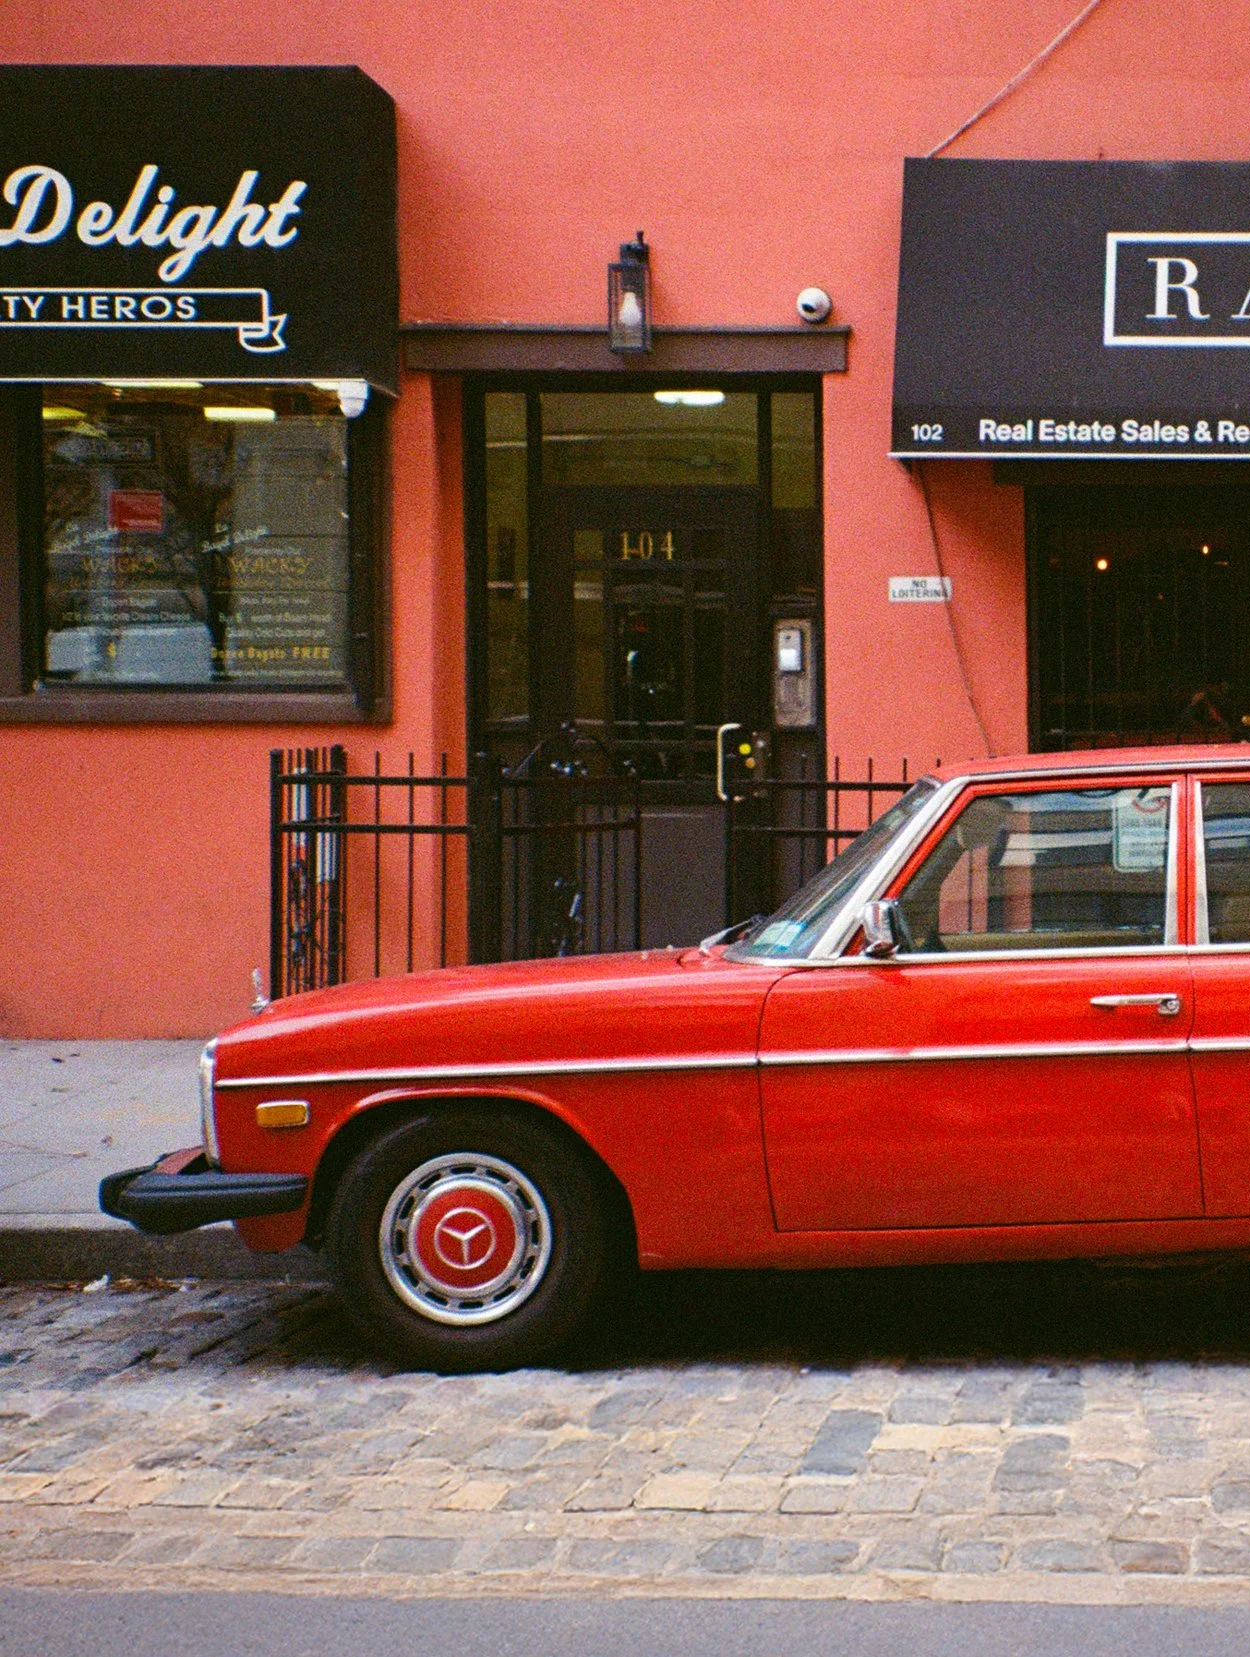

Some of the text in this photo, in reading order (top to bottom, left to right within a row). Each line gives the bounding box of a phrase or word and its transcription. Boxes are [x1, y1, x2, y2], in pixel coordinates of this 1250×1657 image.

[0, 164, 307, 282] Delight
[61, 295, 197, 320] HEROS
[911, 424, 943, 442] 102
[978, 419, 1032, 442] Real
[1038, 419, 1116, 442] Estate
[1120, 419, 1190, 443] Sales
[1194, 420, 1211, 443] &
[619, 530, 675, 561] 104
[912, 579, 928, 588] NO
